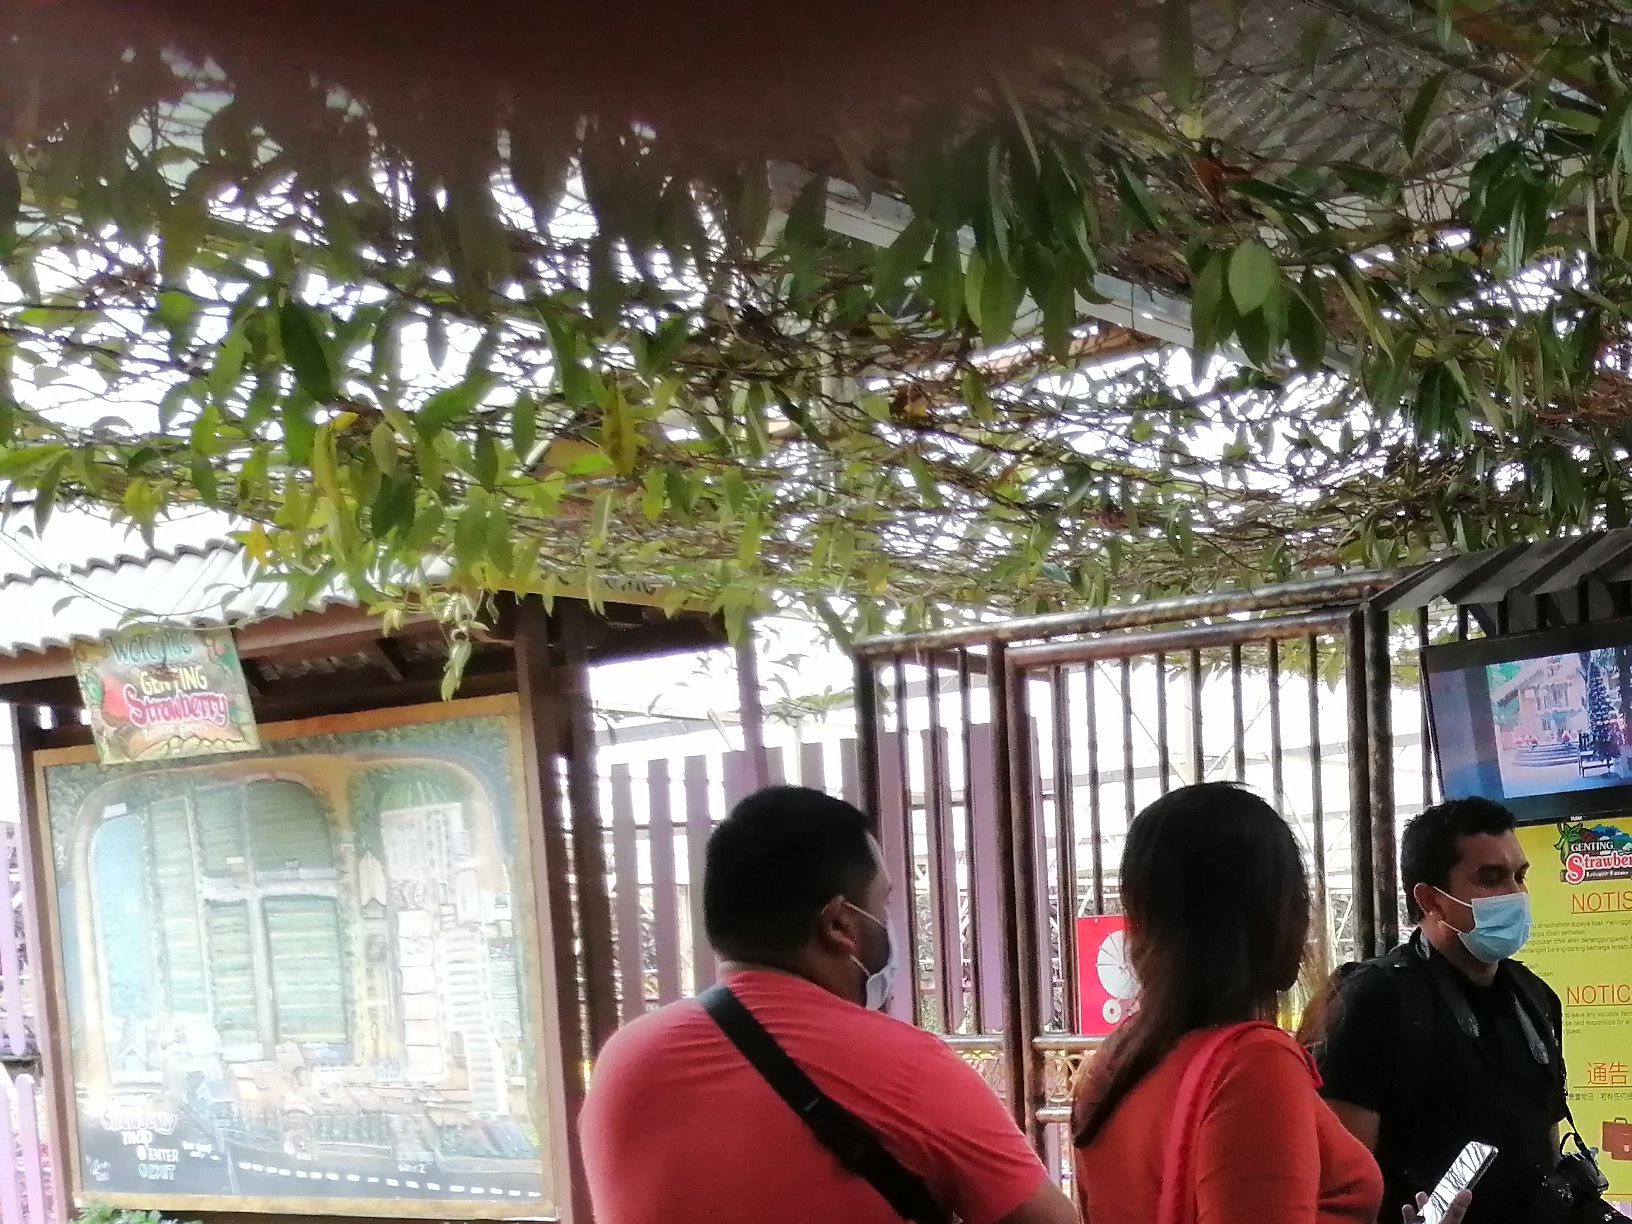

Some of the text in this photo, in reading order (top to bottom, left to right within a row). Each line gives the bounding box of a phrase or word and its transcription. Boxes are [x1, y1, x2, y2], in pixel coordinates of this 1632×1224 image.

[123, 683, 230, 729] Strawberry
[1571, 841, 1614, 852] GENTING
[1586, 1011, 1596, 1019] any
[1585, 1018, 1617, 1027] responsible
[1587, 1061, 1629, 1085] 通告
[147, 1148, 180, 1162] ENTER
